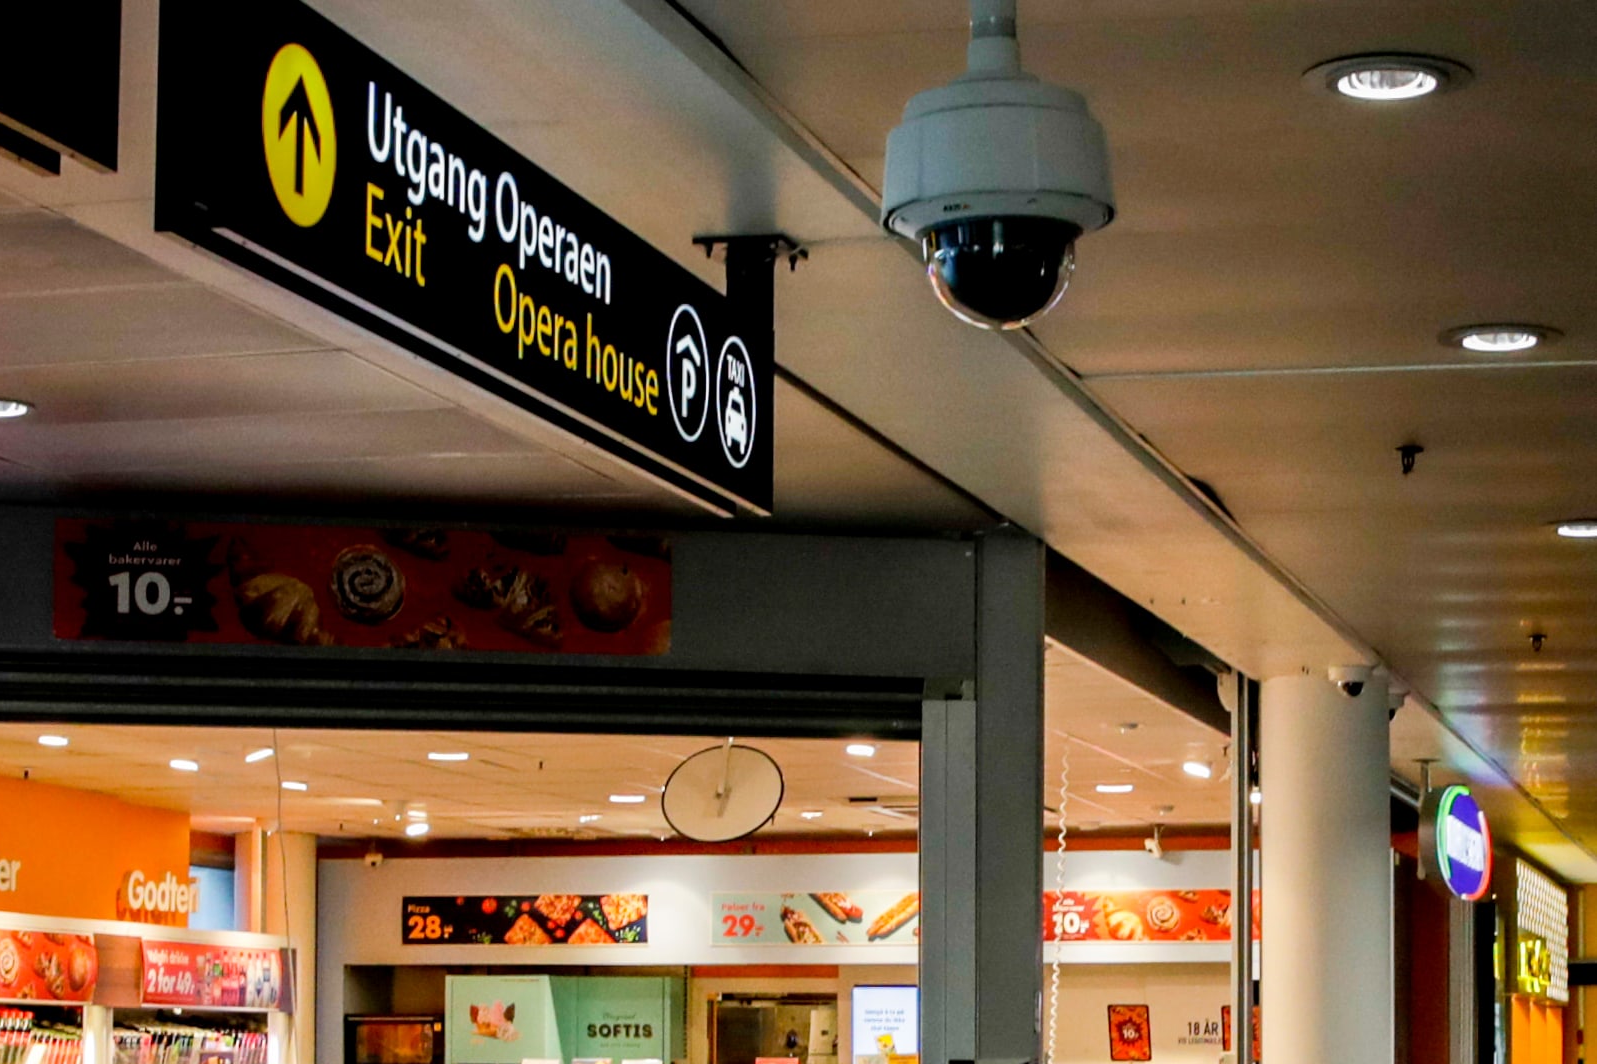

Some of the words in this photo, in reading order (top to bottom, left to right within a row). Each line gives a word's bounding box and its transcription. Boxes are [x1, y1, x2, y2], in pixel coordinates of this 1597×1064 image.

[367, 81, 487, 242] Utgang
[495, 172, 611, 305] Operaen
[365, 182, 427, 287] Exit
[494, 264, 578, 370] Opera
[587, 313, 658, 415] house
[726, 355, 745, 388] TAXI
[133, 541, 157, 551] Alle
[108, 553, 182, 565] bakervarer
[147, 969, 156, 993] 2
[157, 967, 176, 994] for
[587, 1023, 653, 1039] SOFTIS
[1187, 1021, 1200, 1035] 18
[1204, 1018, 1218, 1036] ÅR
